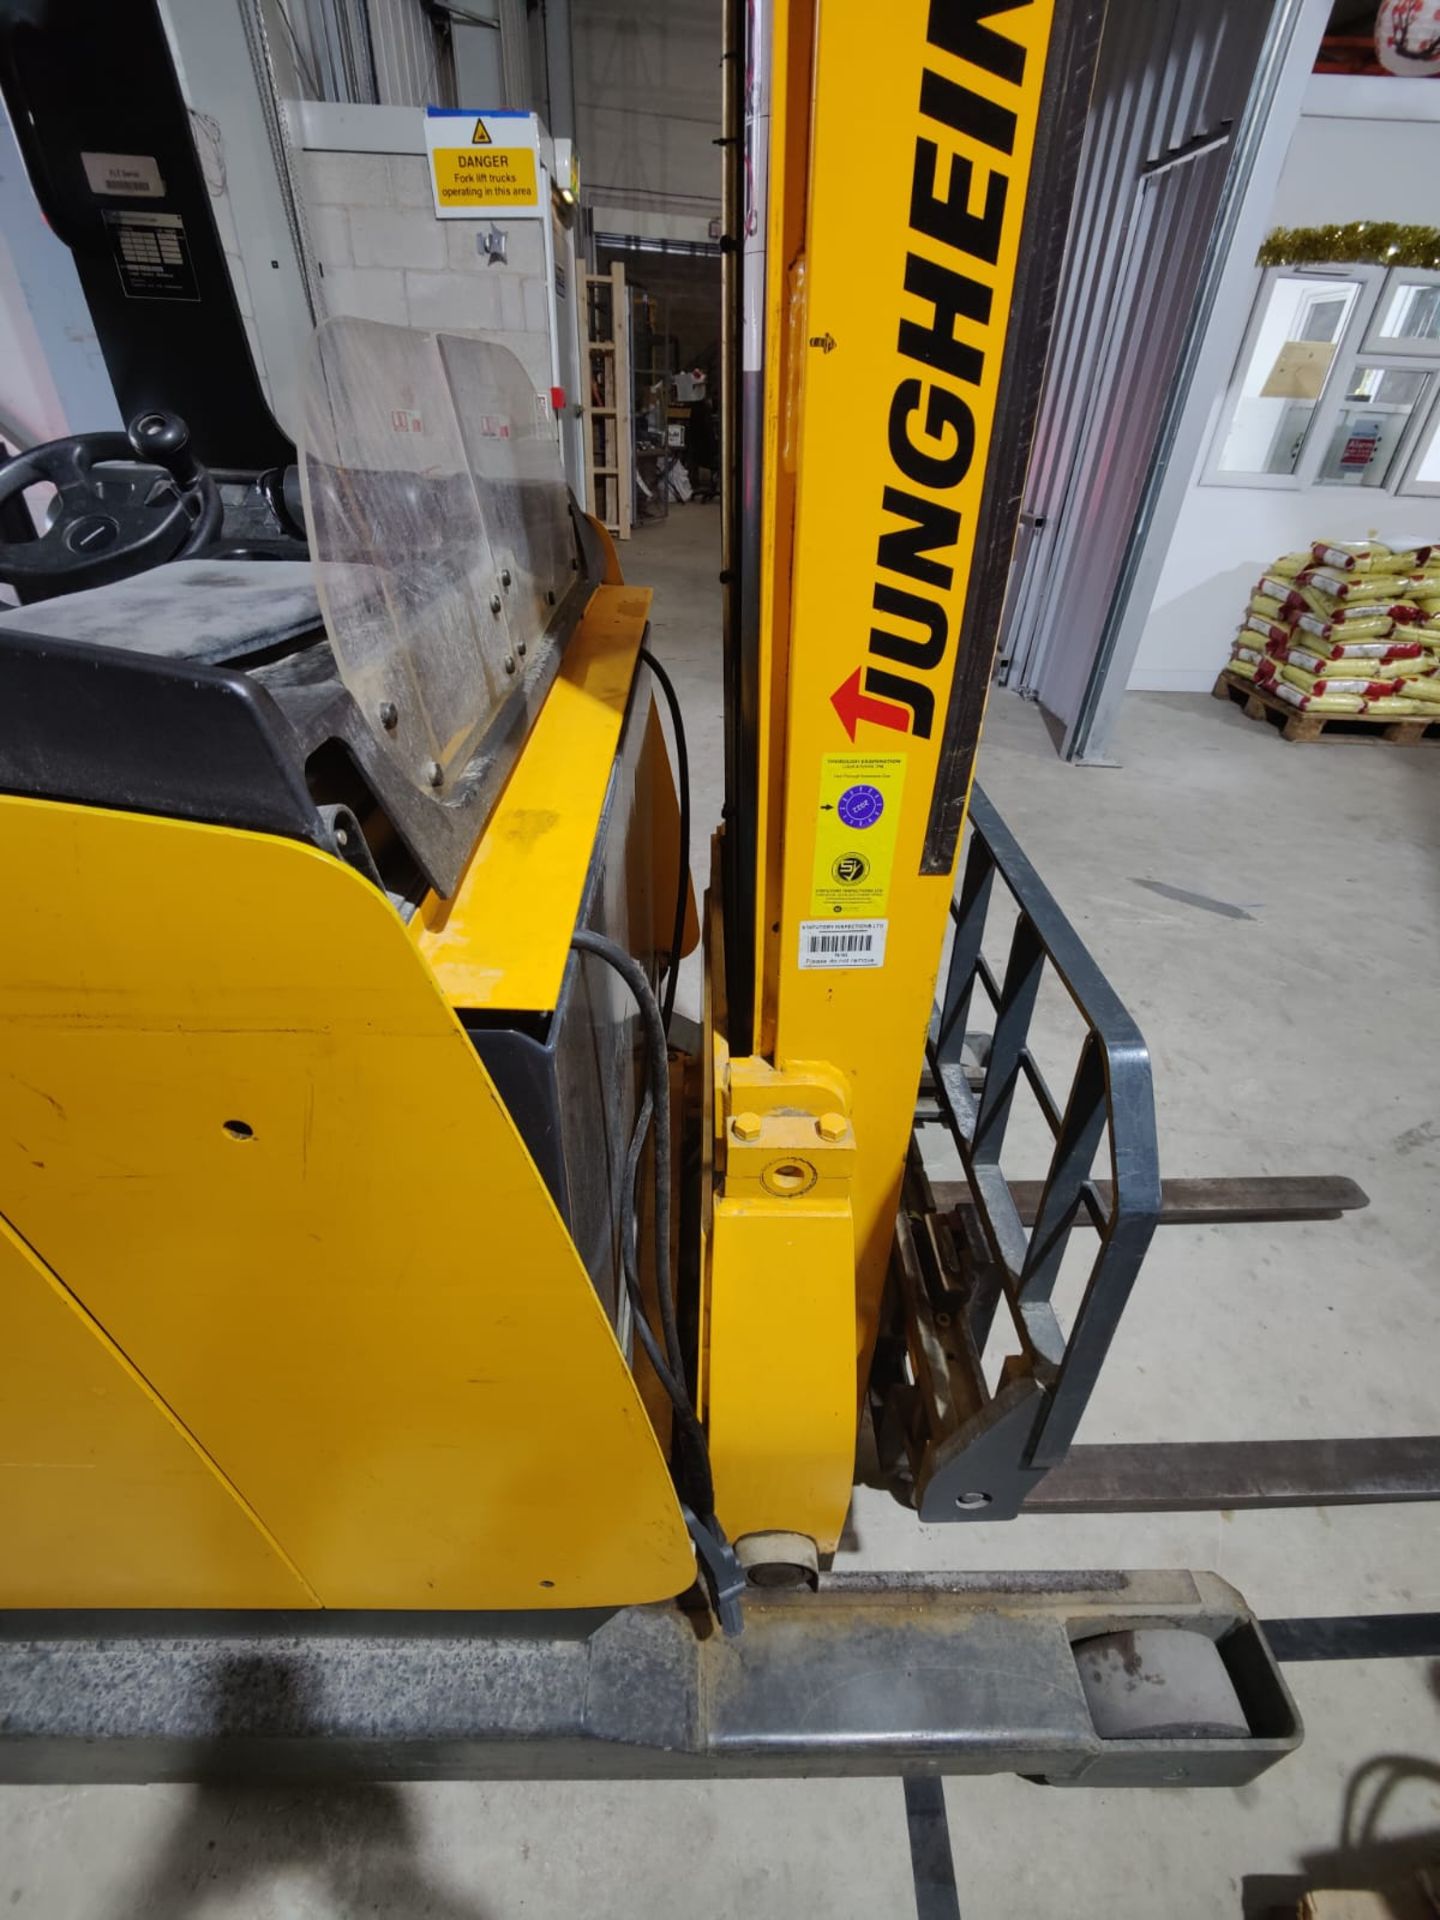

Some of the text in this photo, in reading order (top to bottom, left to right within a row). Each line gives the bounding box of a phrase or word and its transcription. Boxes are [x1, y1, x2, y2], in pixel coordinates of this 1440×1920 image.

[458, 155, 509, 168] DANGER
[454, 173, 516, 182] Fork lift trucks
[442, 187, 532, 198] operating in this area
